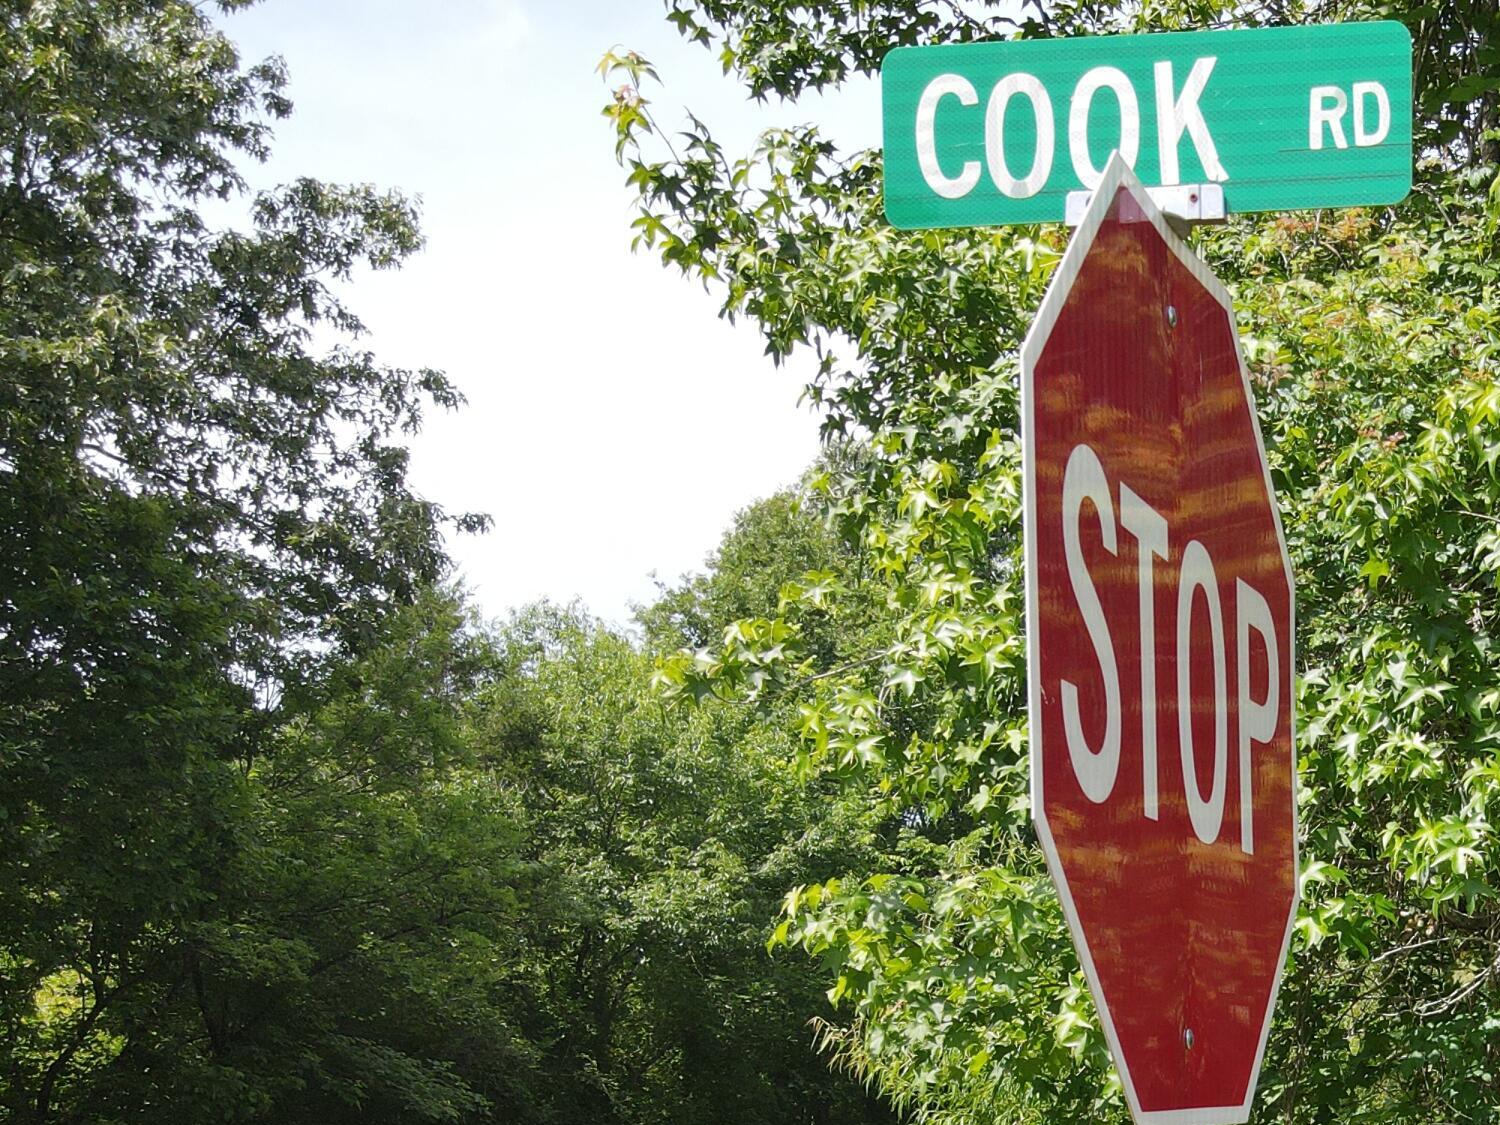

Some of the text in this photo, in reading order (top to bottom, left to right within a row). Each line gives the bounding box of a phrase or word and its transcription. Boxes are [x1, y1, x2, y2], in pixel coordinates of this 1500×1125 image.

[915, 57, 1391, 199] COOK RD
[1061, 443, 1280, 856] STOP
